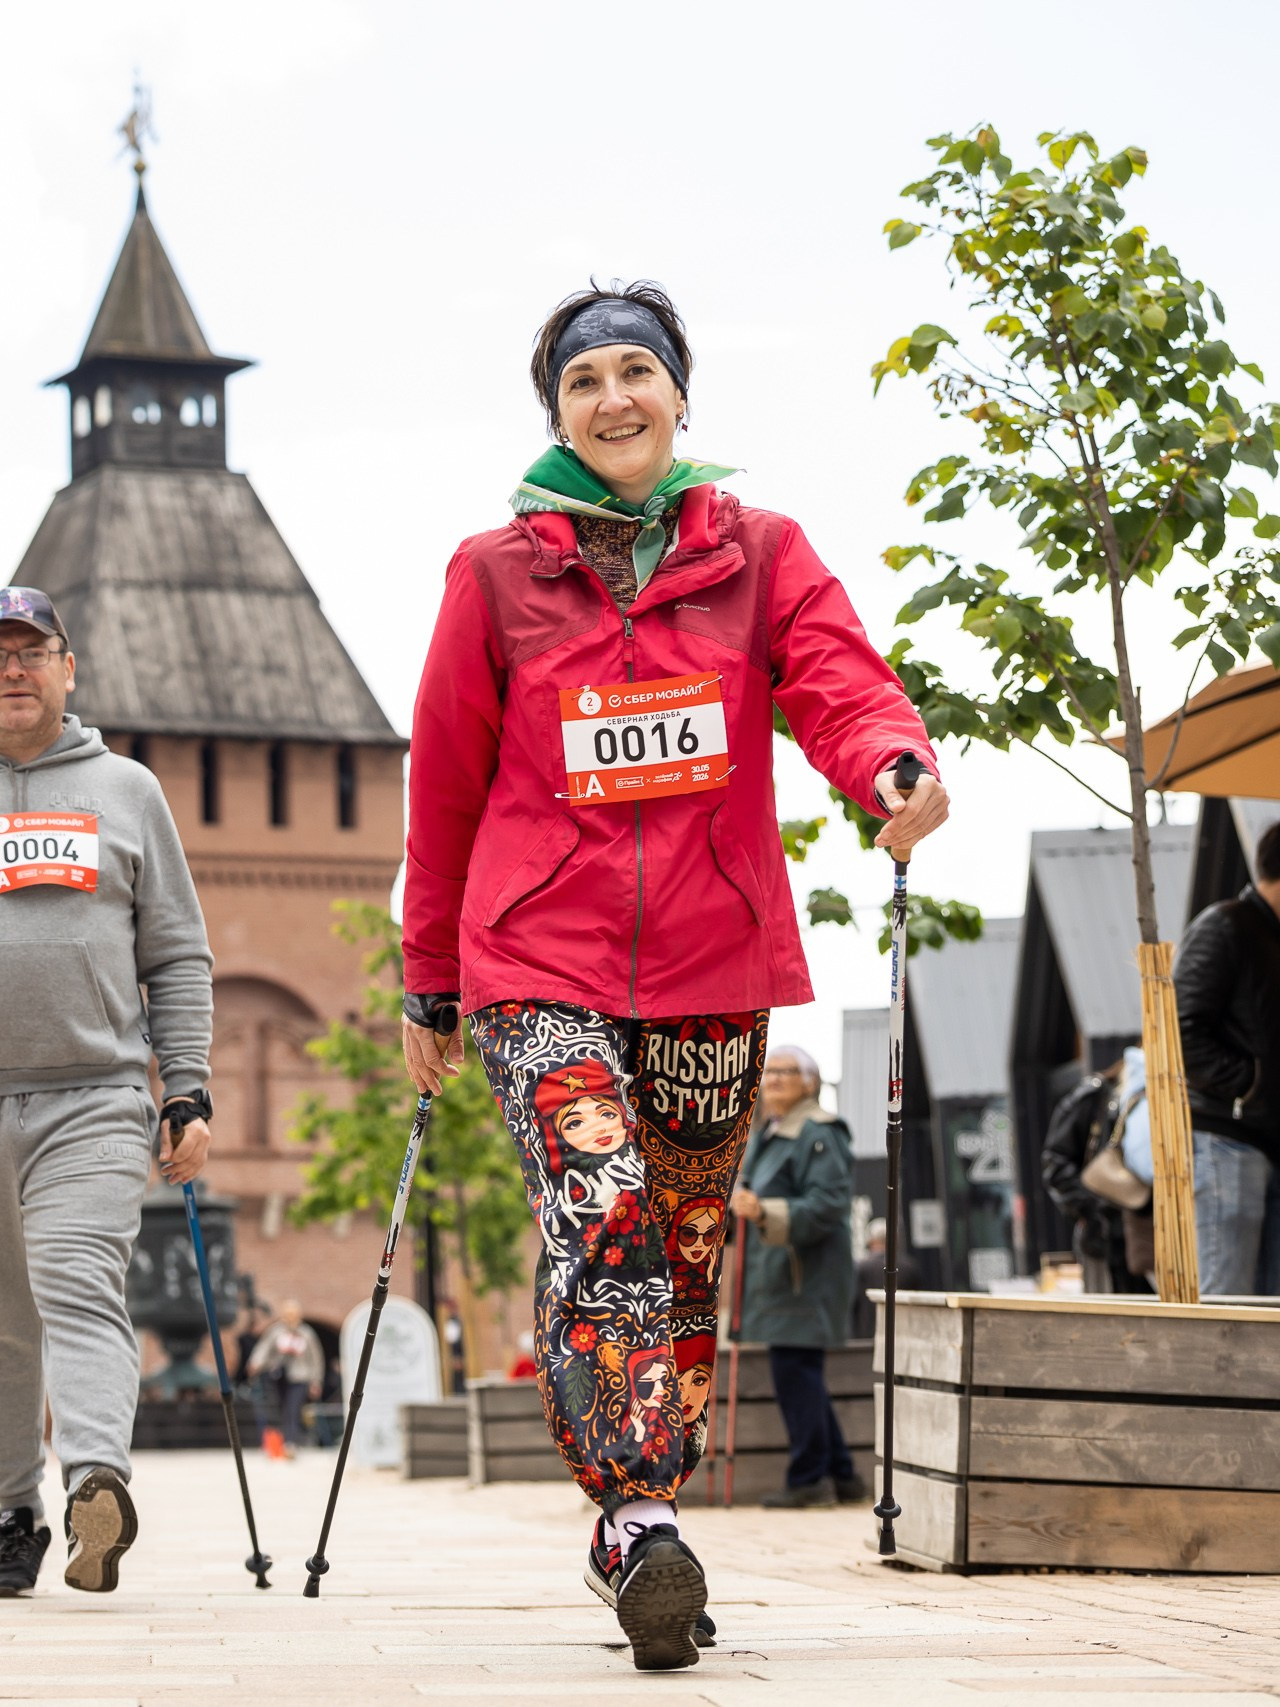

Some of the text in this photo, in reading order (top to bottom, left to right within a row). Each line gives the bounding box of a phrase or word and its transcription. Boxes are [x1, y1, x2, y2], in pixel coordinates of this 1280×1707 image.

[586, 697, 594, 707] 2
[623, 685, 703, 705] СБЕР МОБАЙЛ
[606, 710, 682, 726] СЕВЕРНАЯ ХОДЬБА
[593, 717, 700, 765] 0016
[691, 763, 710, 774] 30.05
[692, 773, 710, 782] 2026
[3, 837, 79, 863] 0004
[647, 1031, 752, 1084] RUSSIAN
[653, 1078, 741, 1124] STYLE
